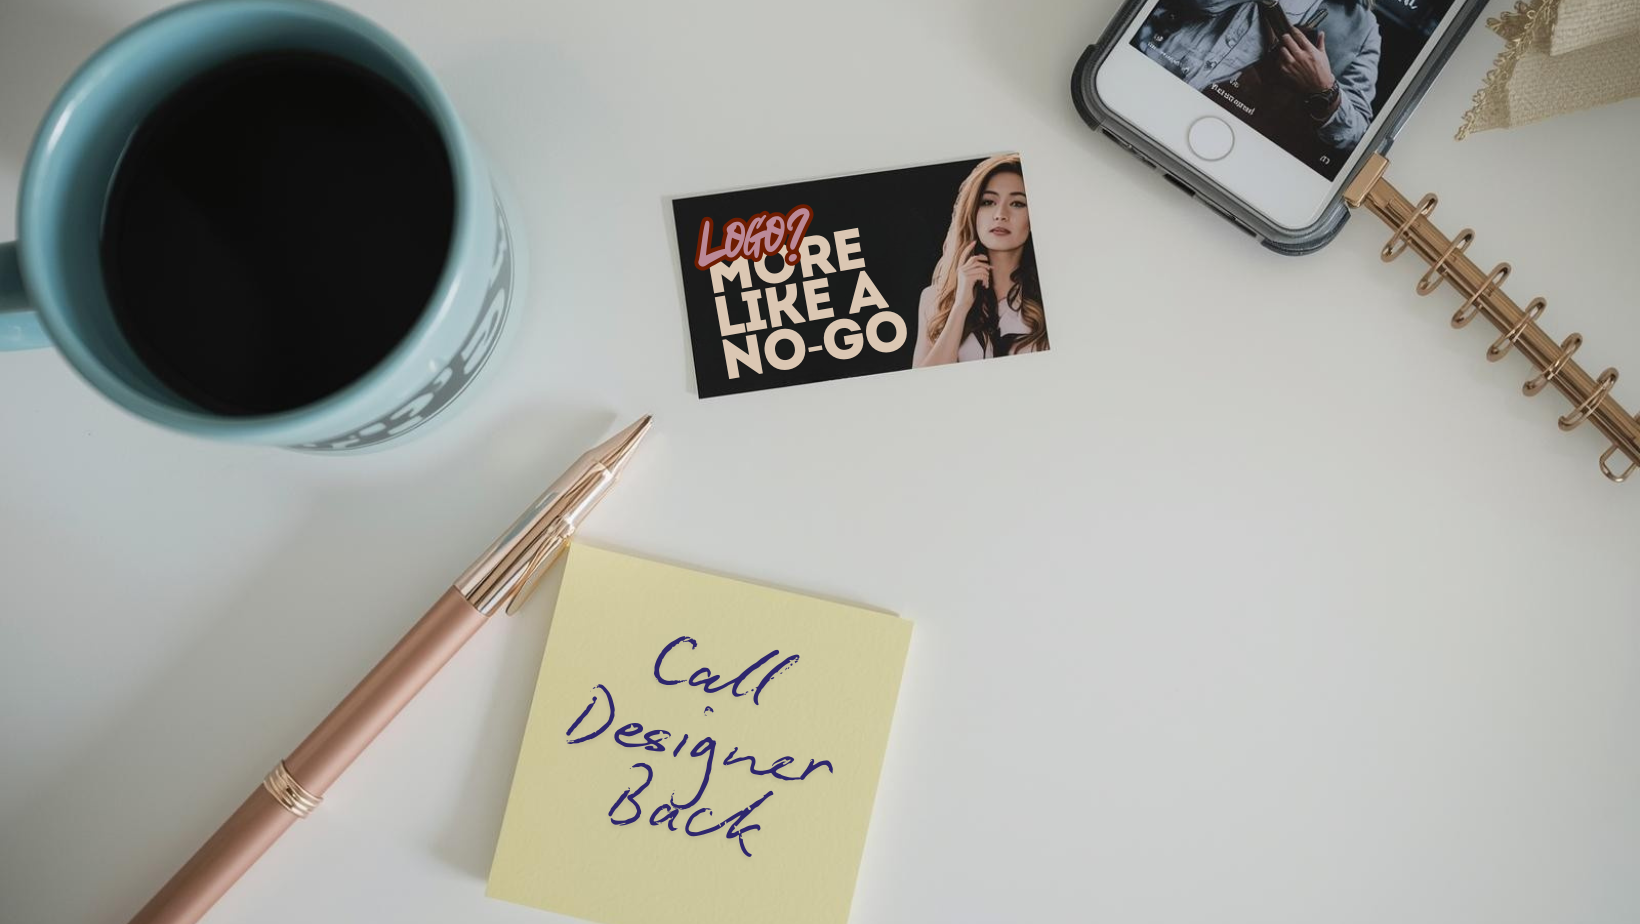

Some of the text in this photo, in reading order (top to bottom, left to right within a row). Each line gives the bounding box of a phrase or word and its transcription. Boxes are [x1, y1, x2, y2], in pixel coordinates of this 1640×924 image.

[695, 204, 814, 270] LOGO?
[709, 227, 866, 294] MORE
[714, 270, 889, 337] LIKE A
[722, 310, 908, 380] NO-GO
[653, 635, 800, 706] Call
[565, 684, 834, 810] Designer
[607, 762, 774, 858] Back
